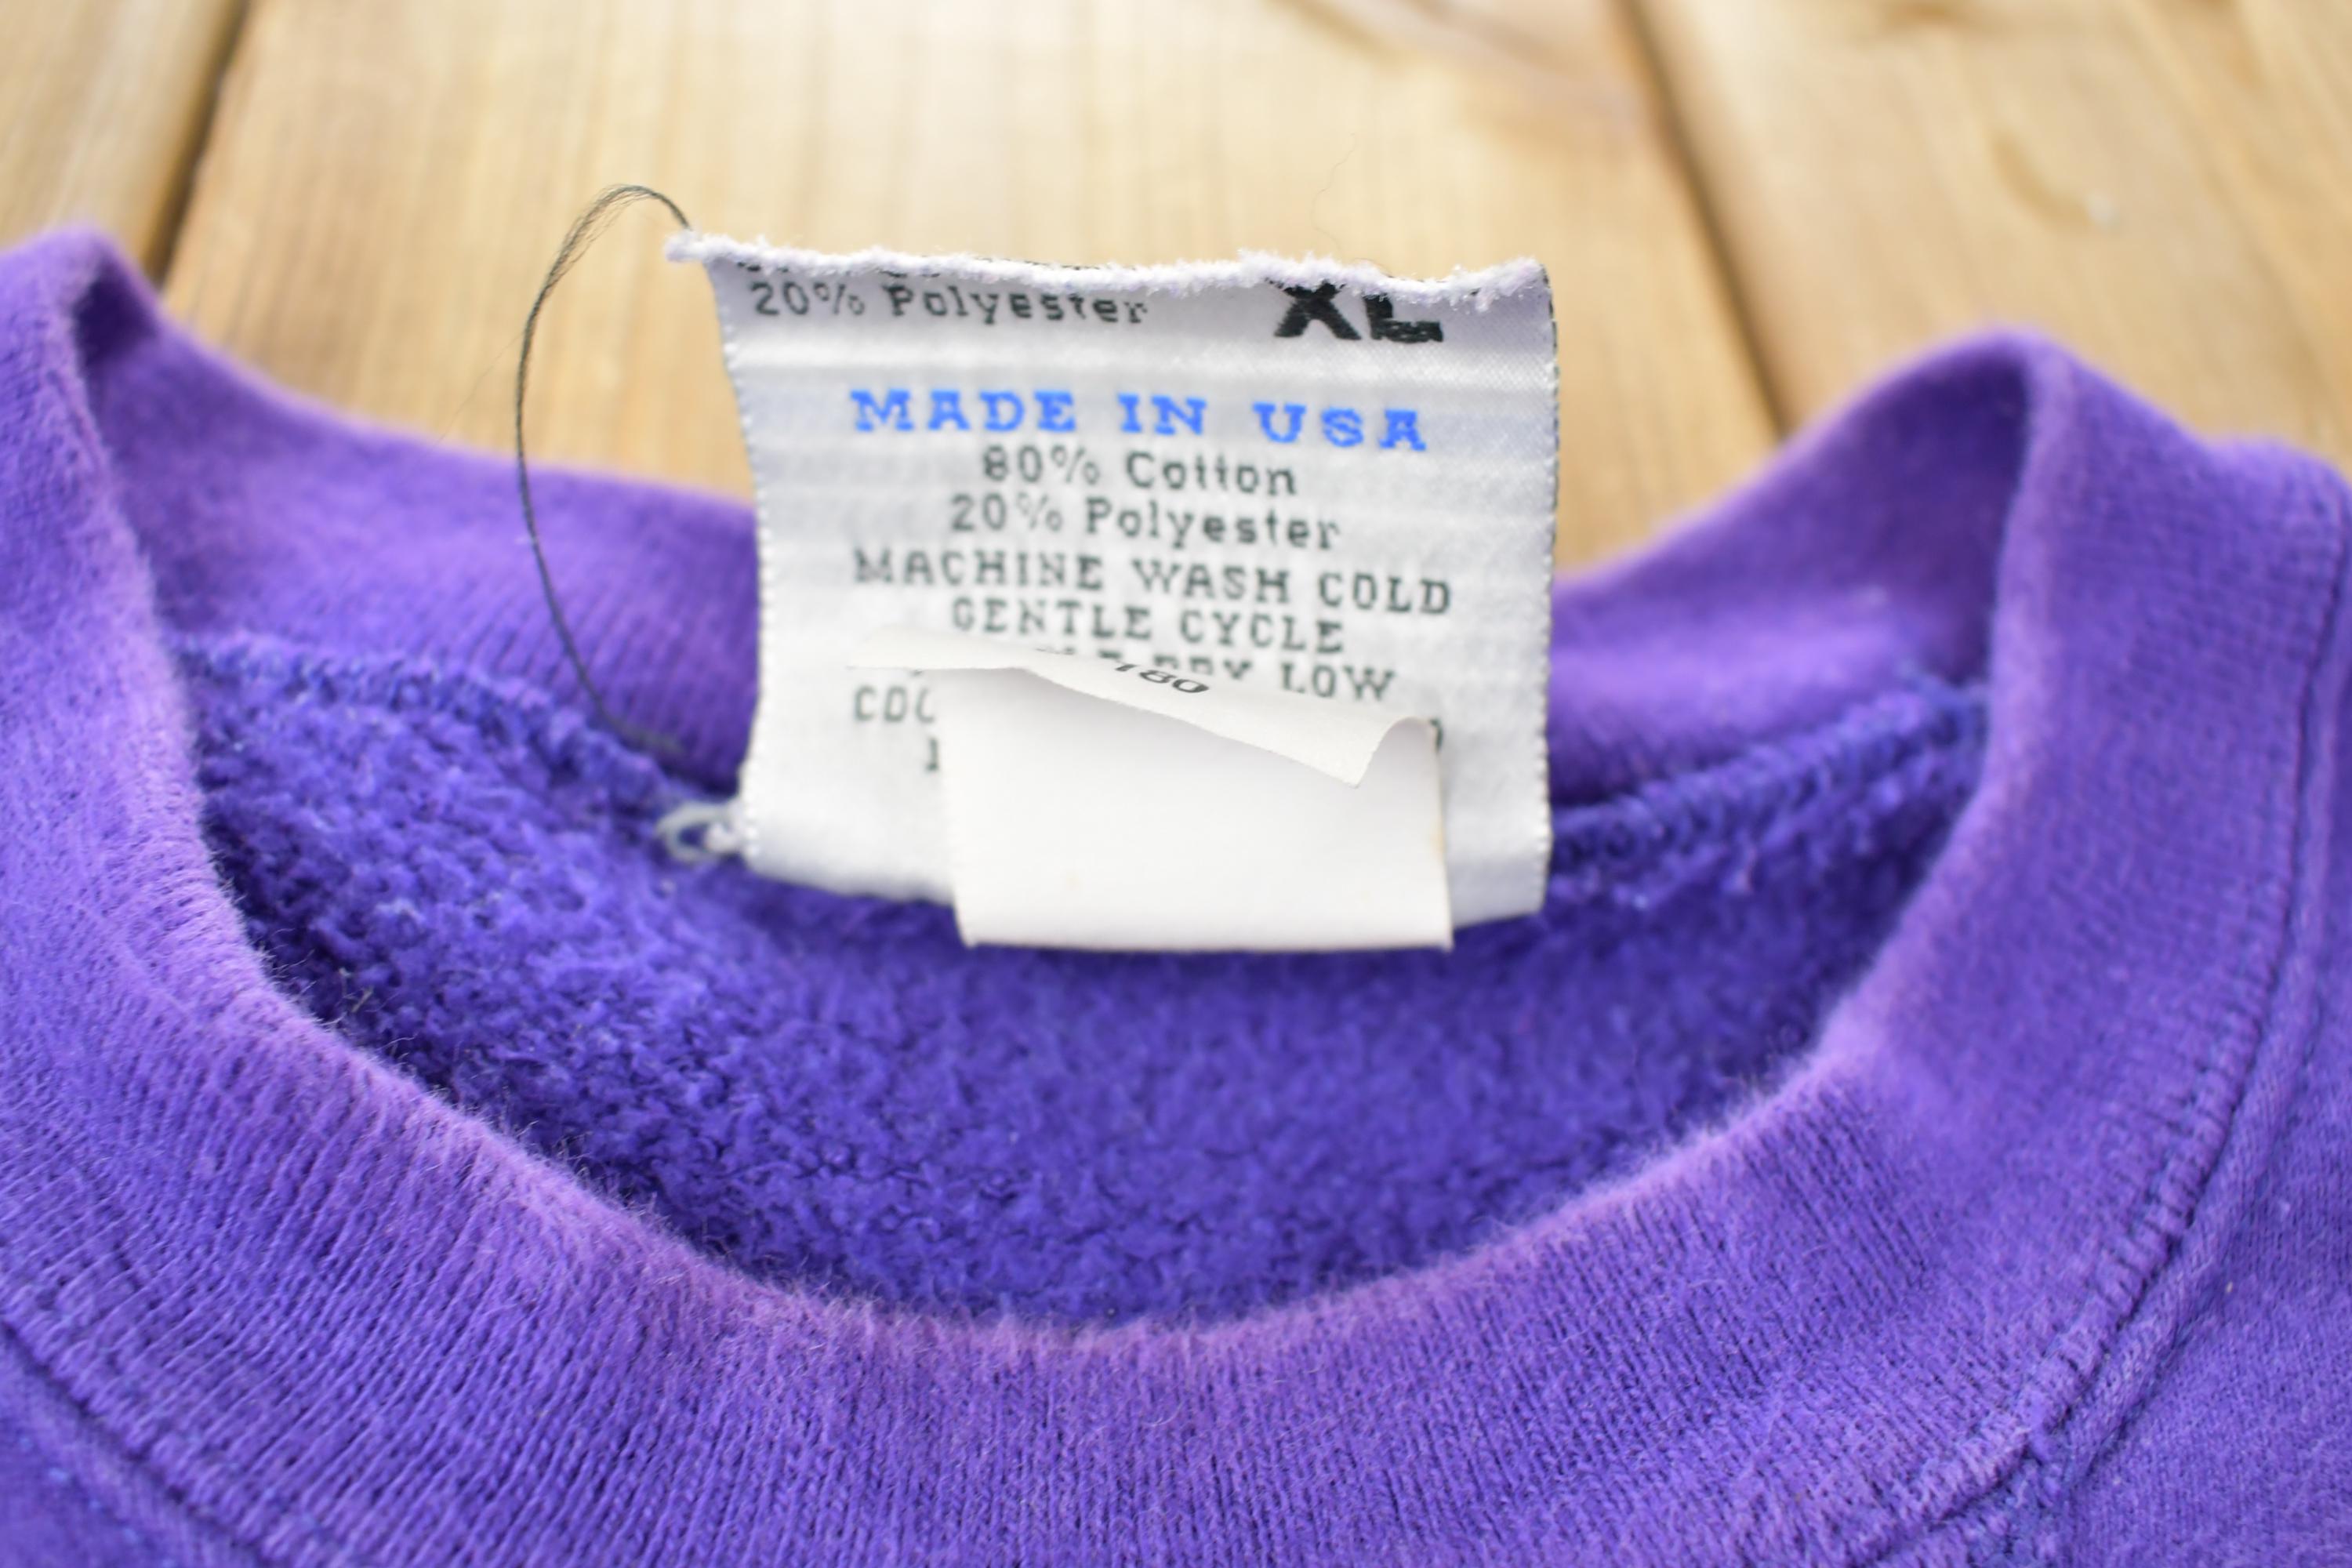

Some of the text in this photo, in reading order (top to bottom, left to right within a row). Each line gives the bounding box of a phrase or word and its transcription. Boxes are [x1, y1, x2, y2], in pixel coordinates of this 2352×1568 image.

[751, 282, 1146, 324] 20% Polyester
[1265, 278, 1444, 343] XL
[851, 389, 1427, 451] MADE IN USA
[983, 445, 1295, 495] 80% Cotton
[950, 494, 1339, 549] 20% Polyester
[855, 550, 1450, 615] MACHINE WASH COLD
[953, 596, 1344, 655] GENTLE CYCLE
[1281, 663, 1394, 702] LOW
